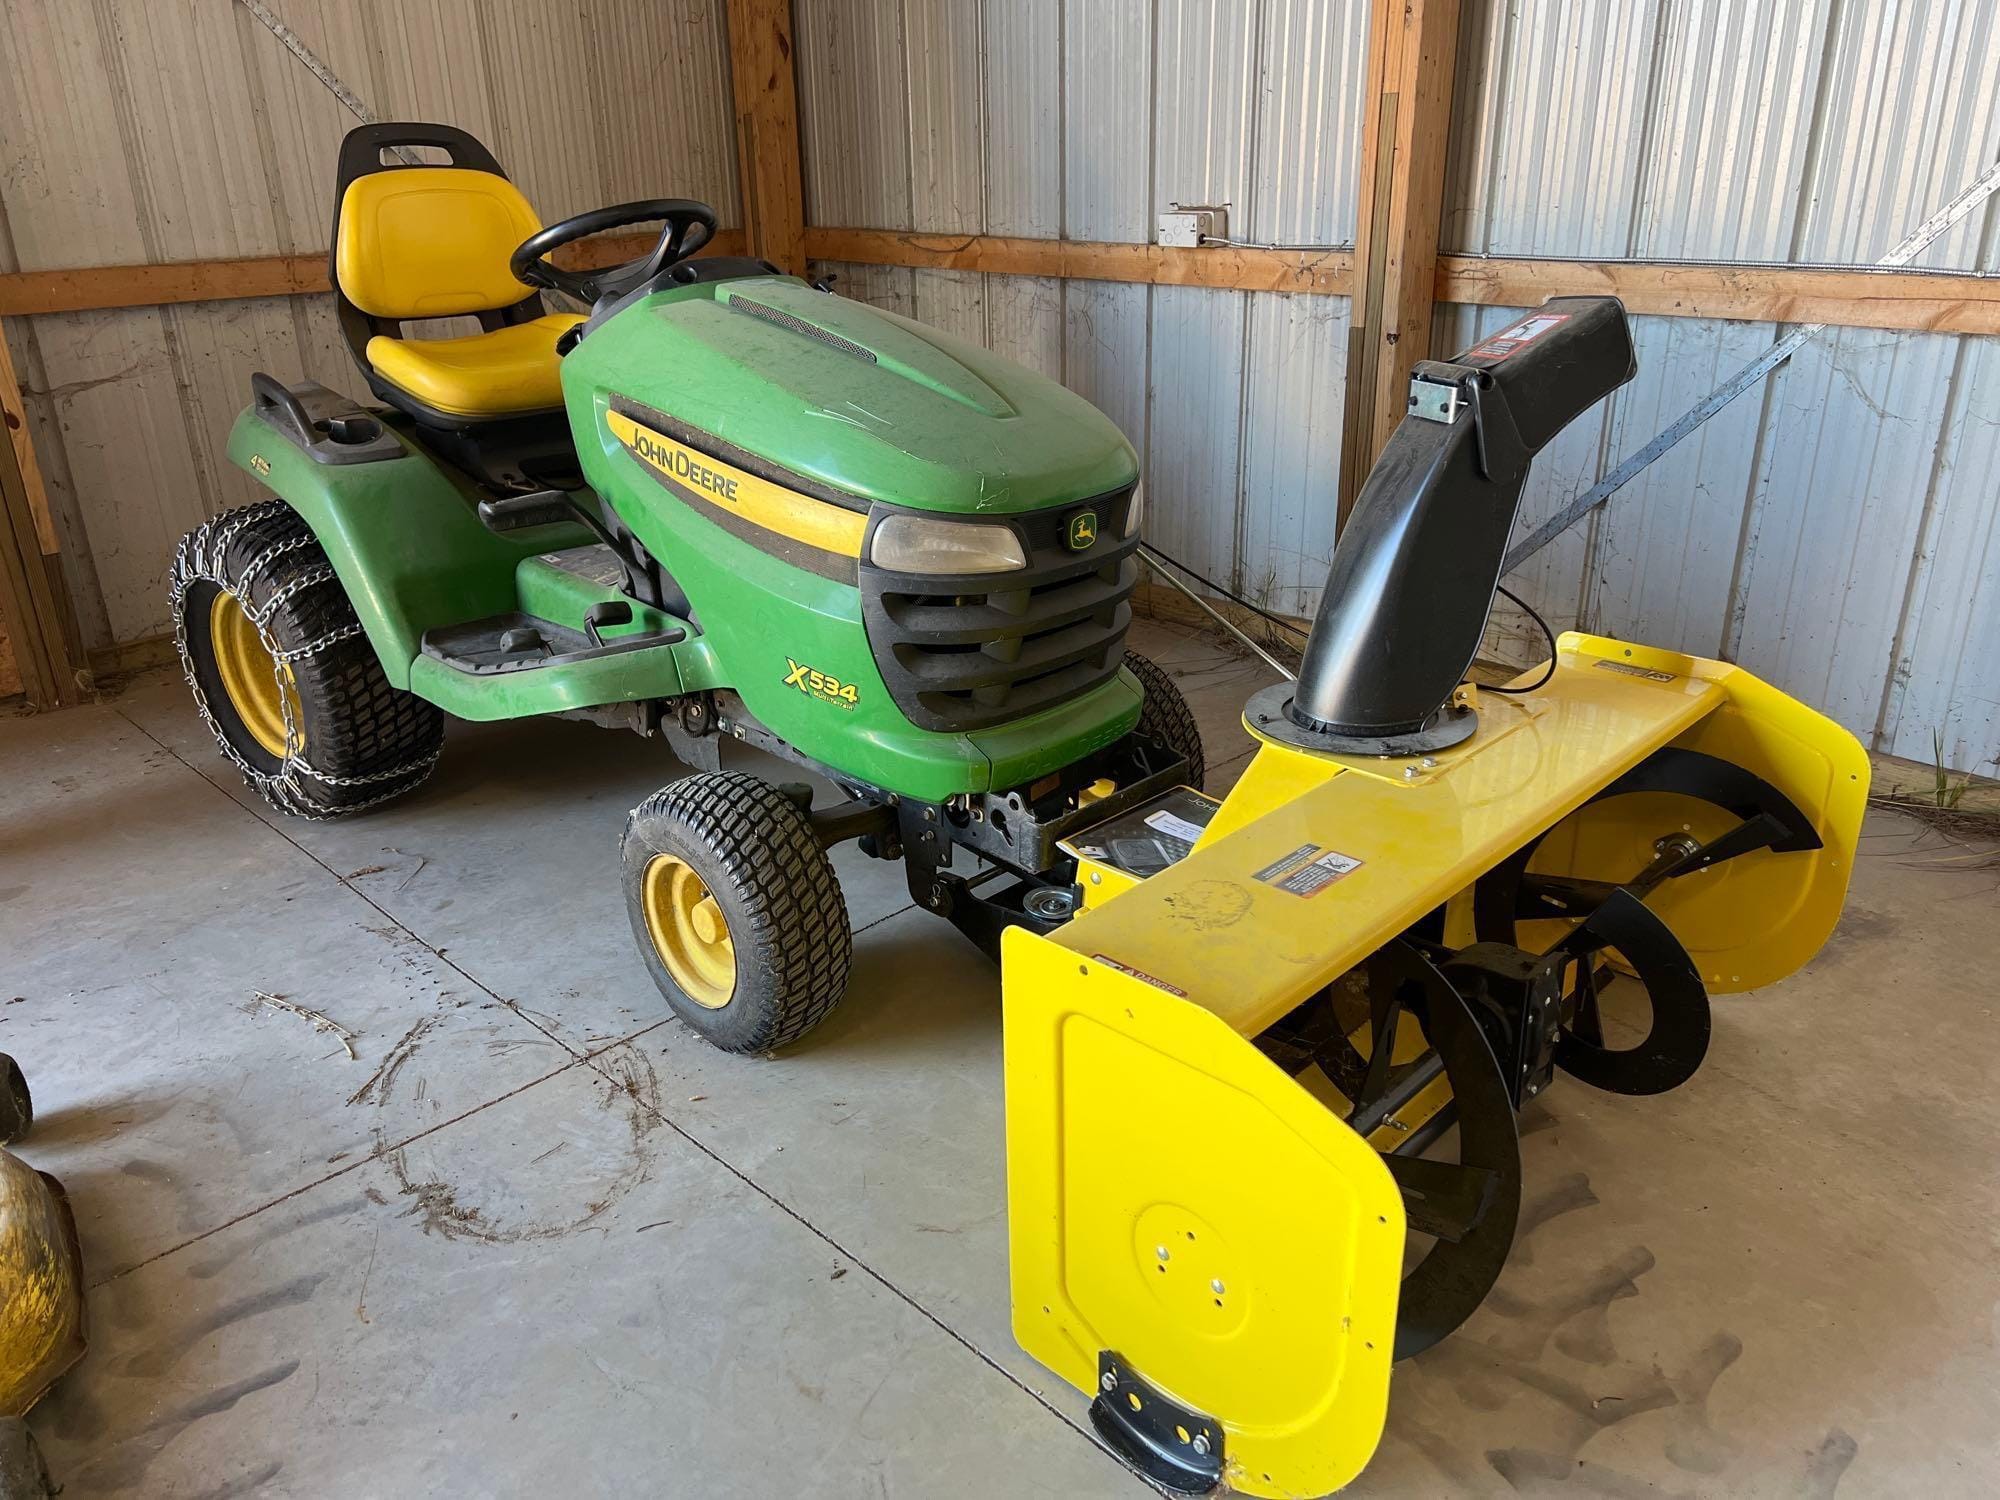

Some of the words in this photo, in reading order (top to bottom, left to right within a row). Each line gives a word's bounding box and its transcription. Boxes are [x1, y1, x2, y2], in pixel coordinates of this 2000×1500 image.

[630, 428, 673, 471] JOHN
[676, 450, 738, 502] DEERE
[782, 656, 859, 704] X534
[1135, 972, 1183, 996] DANGER
